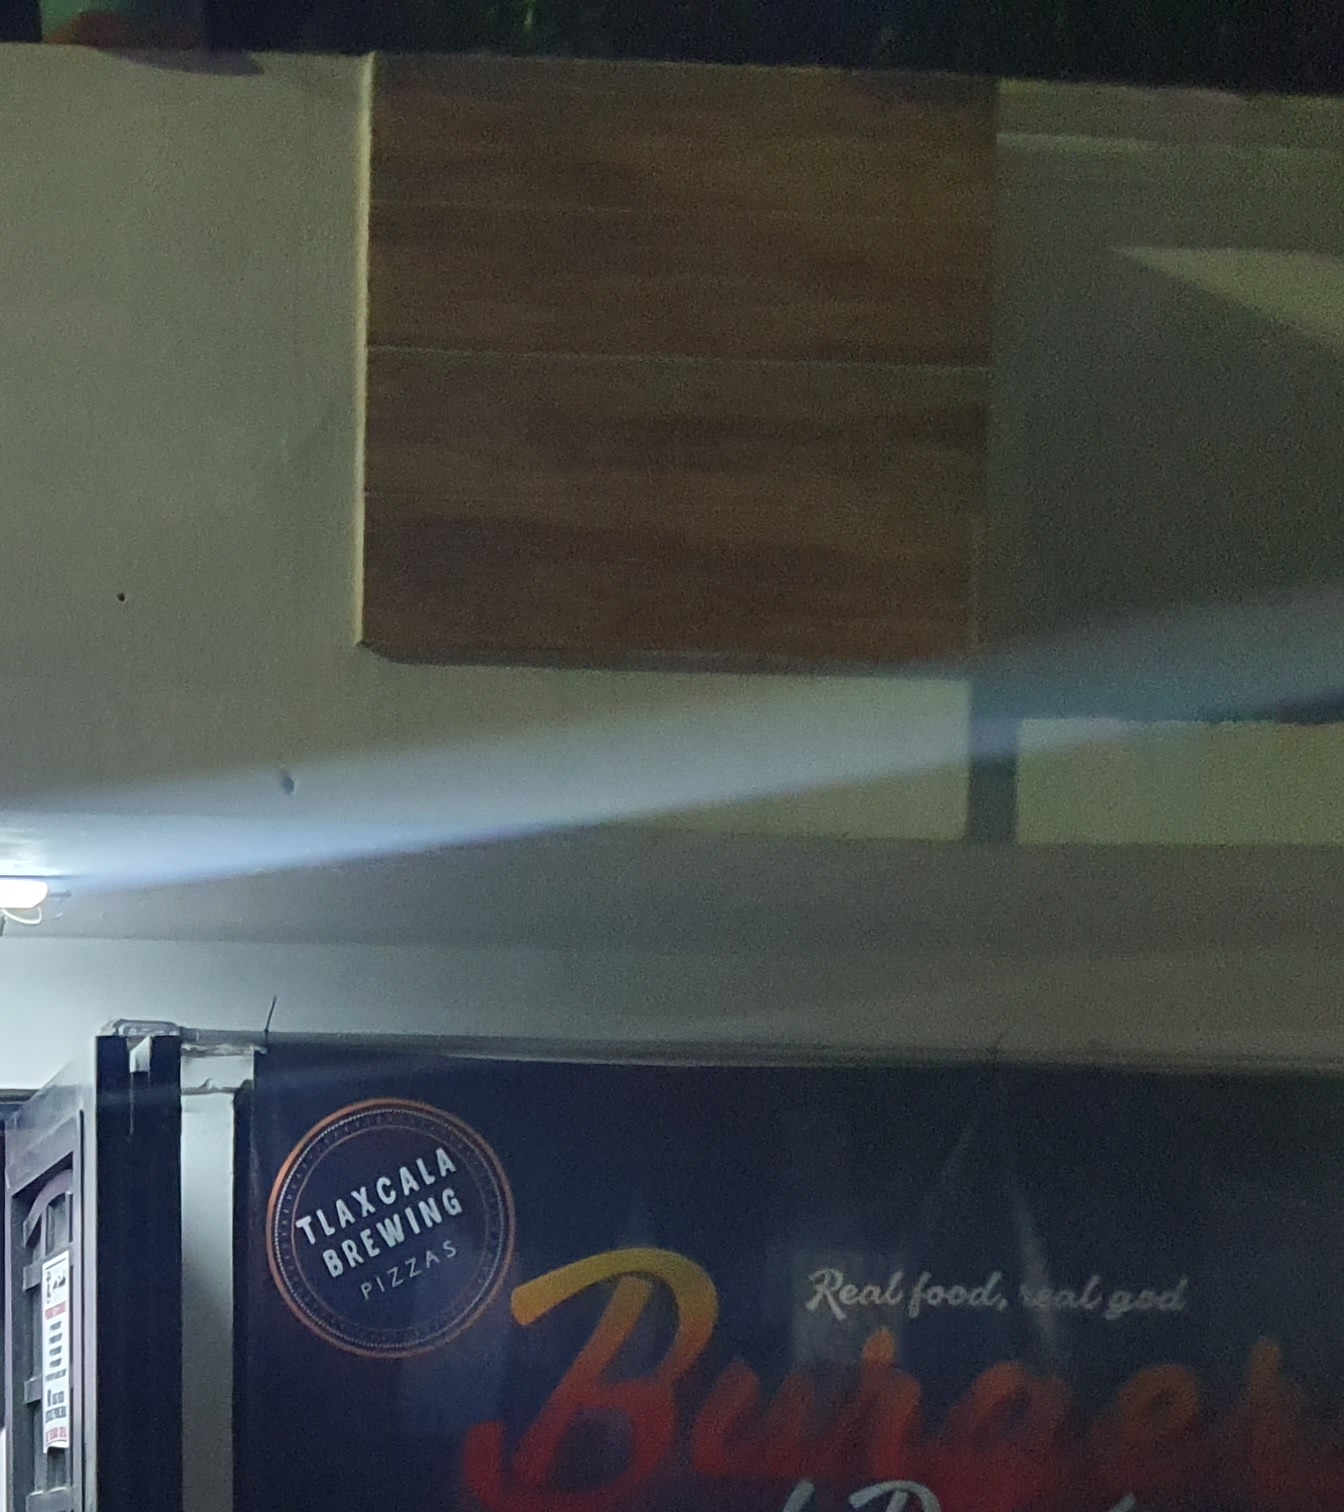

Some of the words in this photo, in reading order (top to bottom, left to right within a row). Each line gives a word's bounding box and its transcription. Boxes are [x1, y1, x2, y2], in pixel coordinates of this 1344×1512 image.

[295, 1146, 458, 1247] TLAXCALA
[322, 1186, 464, 1279] BREWING
[359, 1239, 459, 1300] PIZZAS
[806, 1267, 906, 1321] Real
[908, 1271, 1009, 1319] food,
